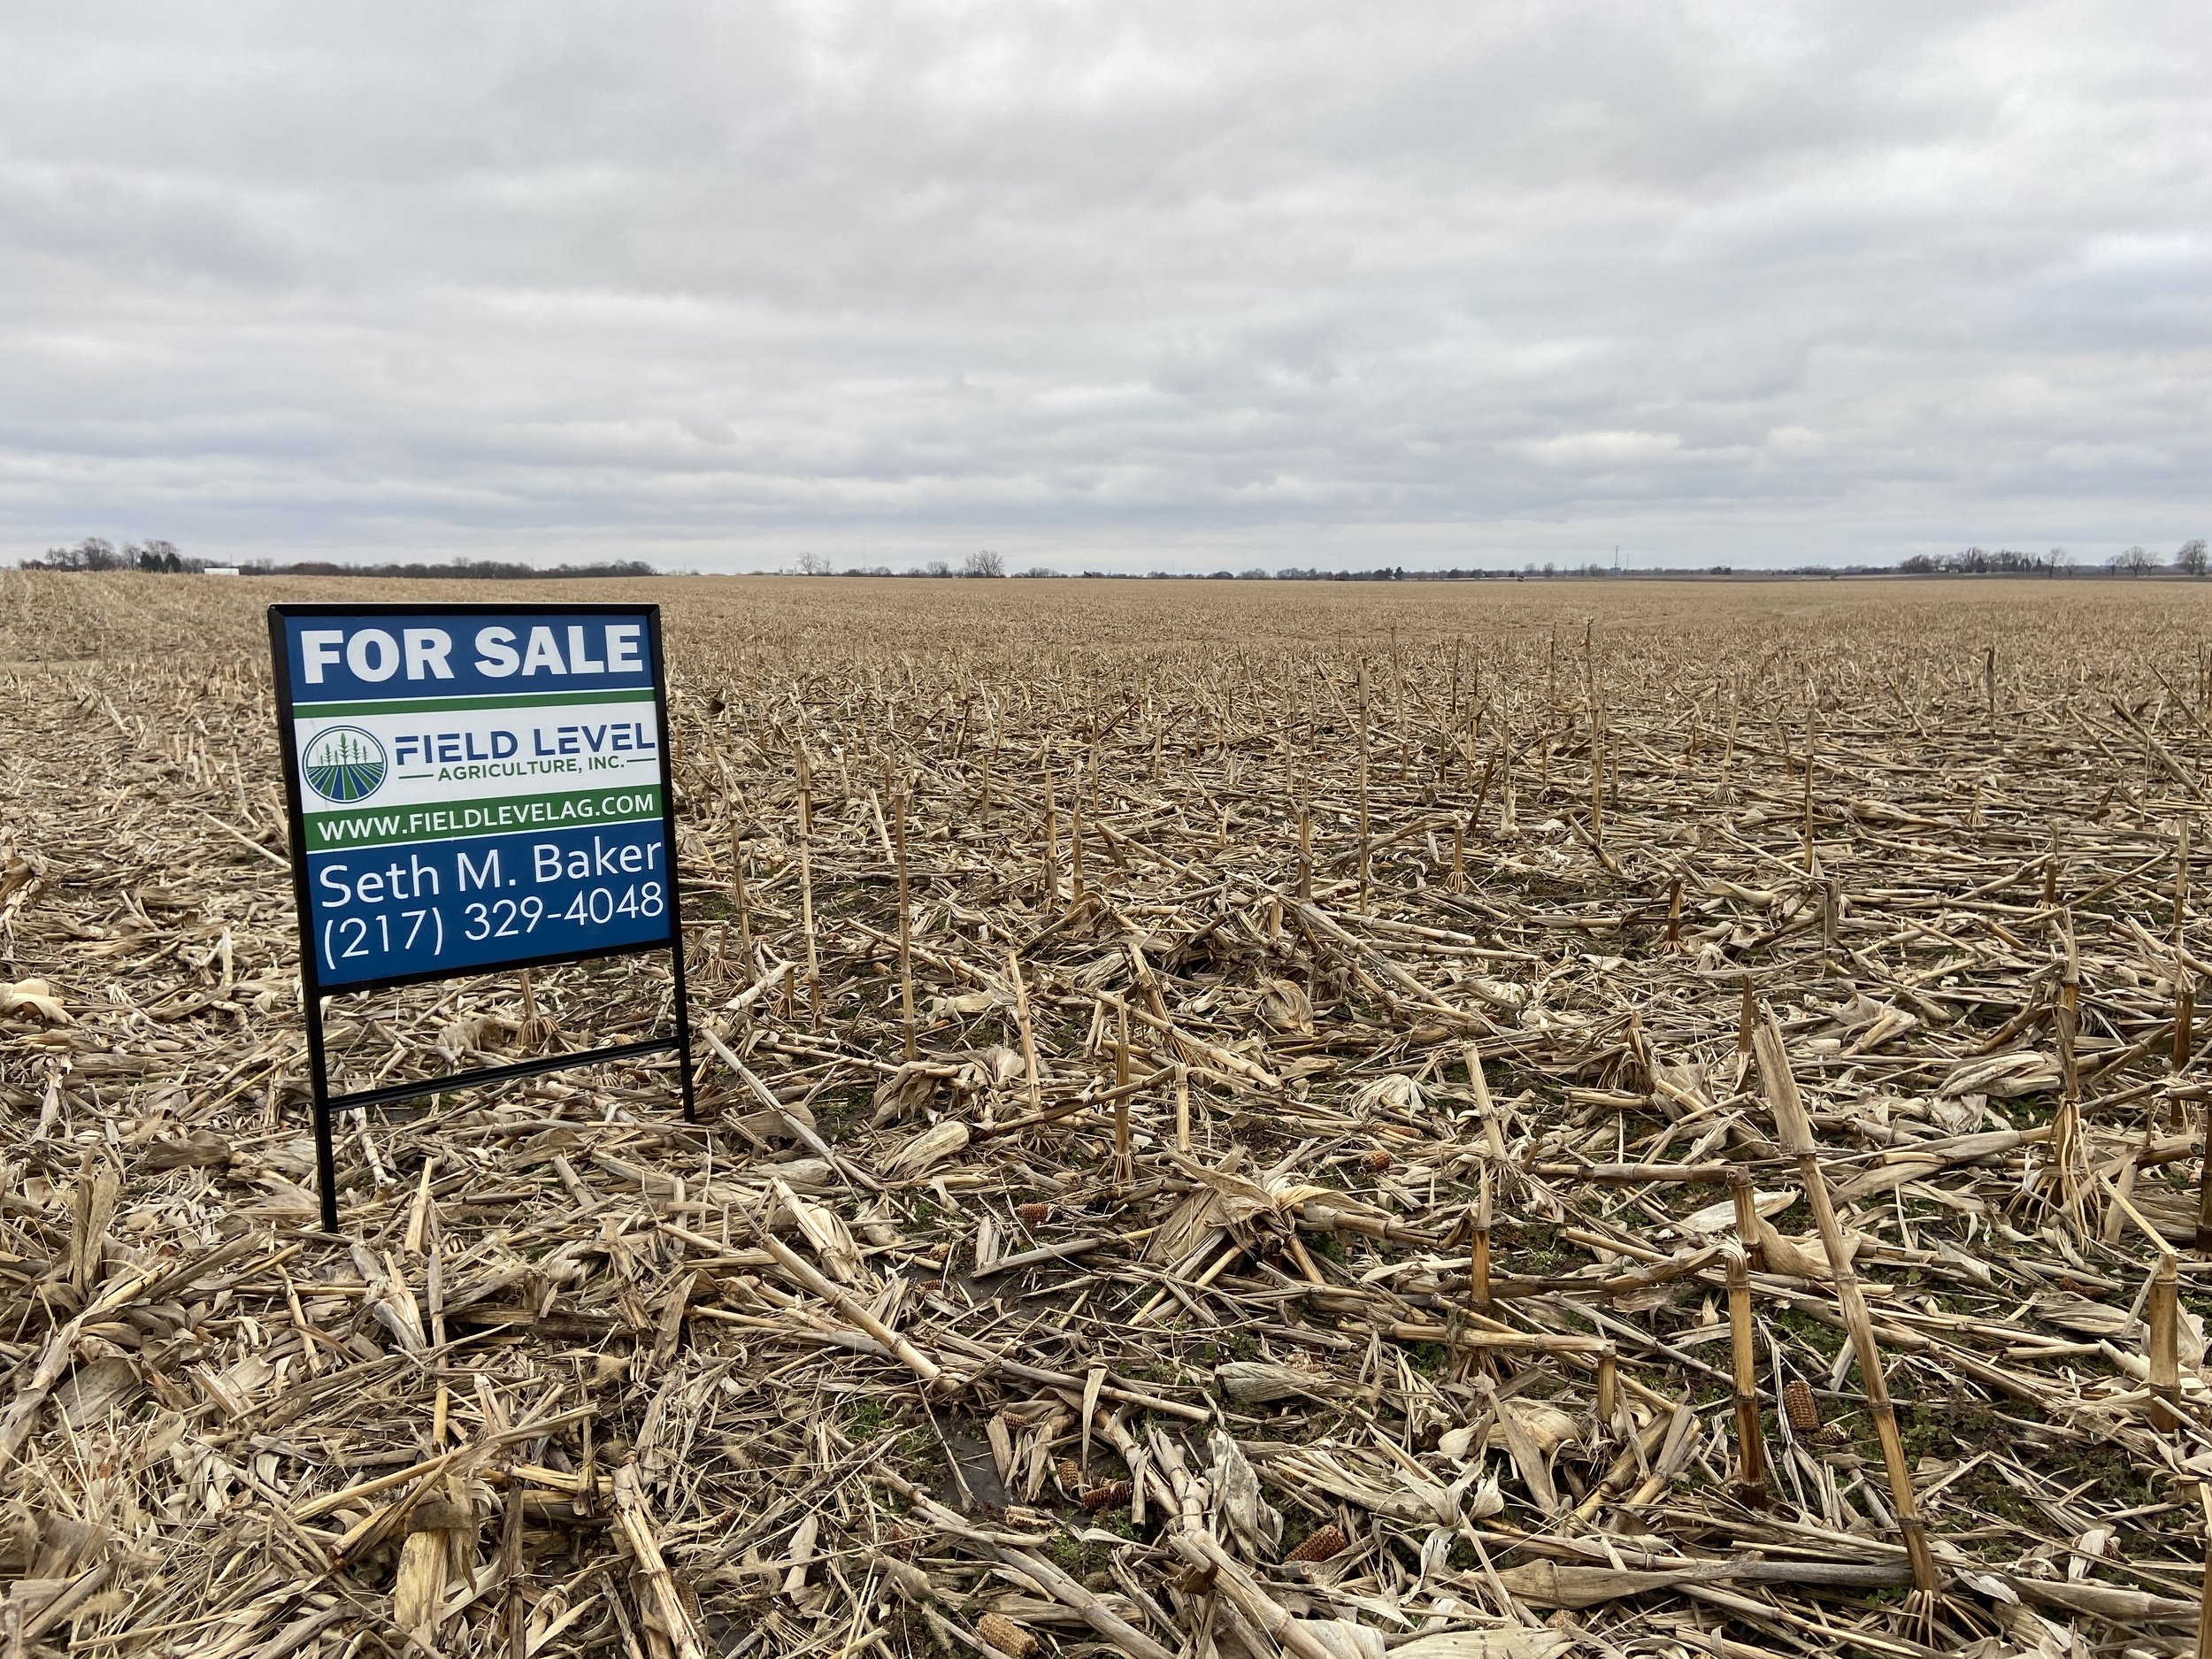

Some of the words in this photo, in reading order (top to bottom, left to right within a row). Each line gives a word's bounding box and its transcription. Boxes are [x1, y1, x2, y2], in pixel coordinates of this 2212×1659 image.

[302, 628, 455, 684] FOR
[474, 625, 643, 677] SALE
[395, 730, 518, 765] FIELD
[534, 722, 656, 757] LEVEL
[438, 758, 583, 782] AGRICULTURE,
[588, 755, 625, 771] INC.
[318, 794, 654, 841] WWW.FIELDLEVELAG.COM
[320, 854, 439, 908] Seth
[457, 849, 515, 892] M.
[534, 836, 662, 883] Baker
[323, 907, 443, 970] (217)
[465, 881, 664, 941] 329-4048
